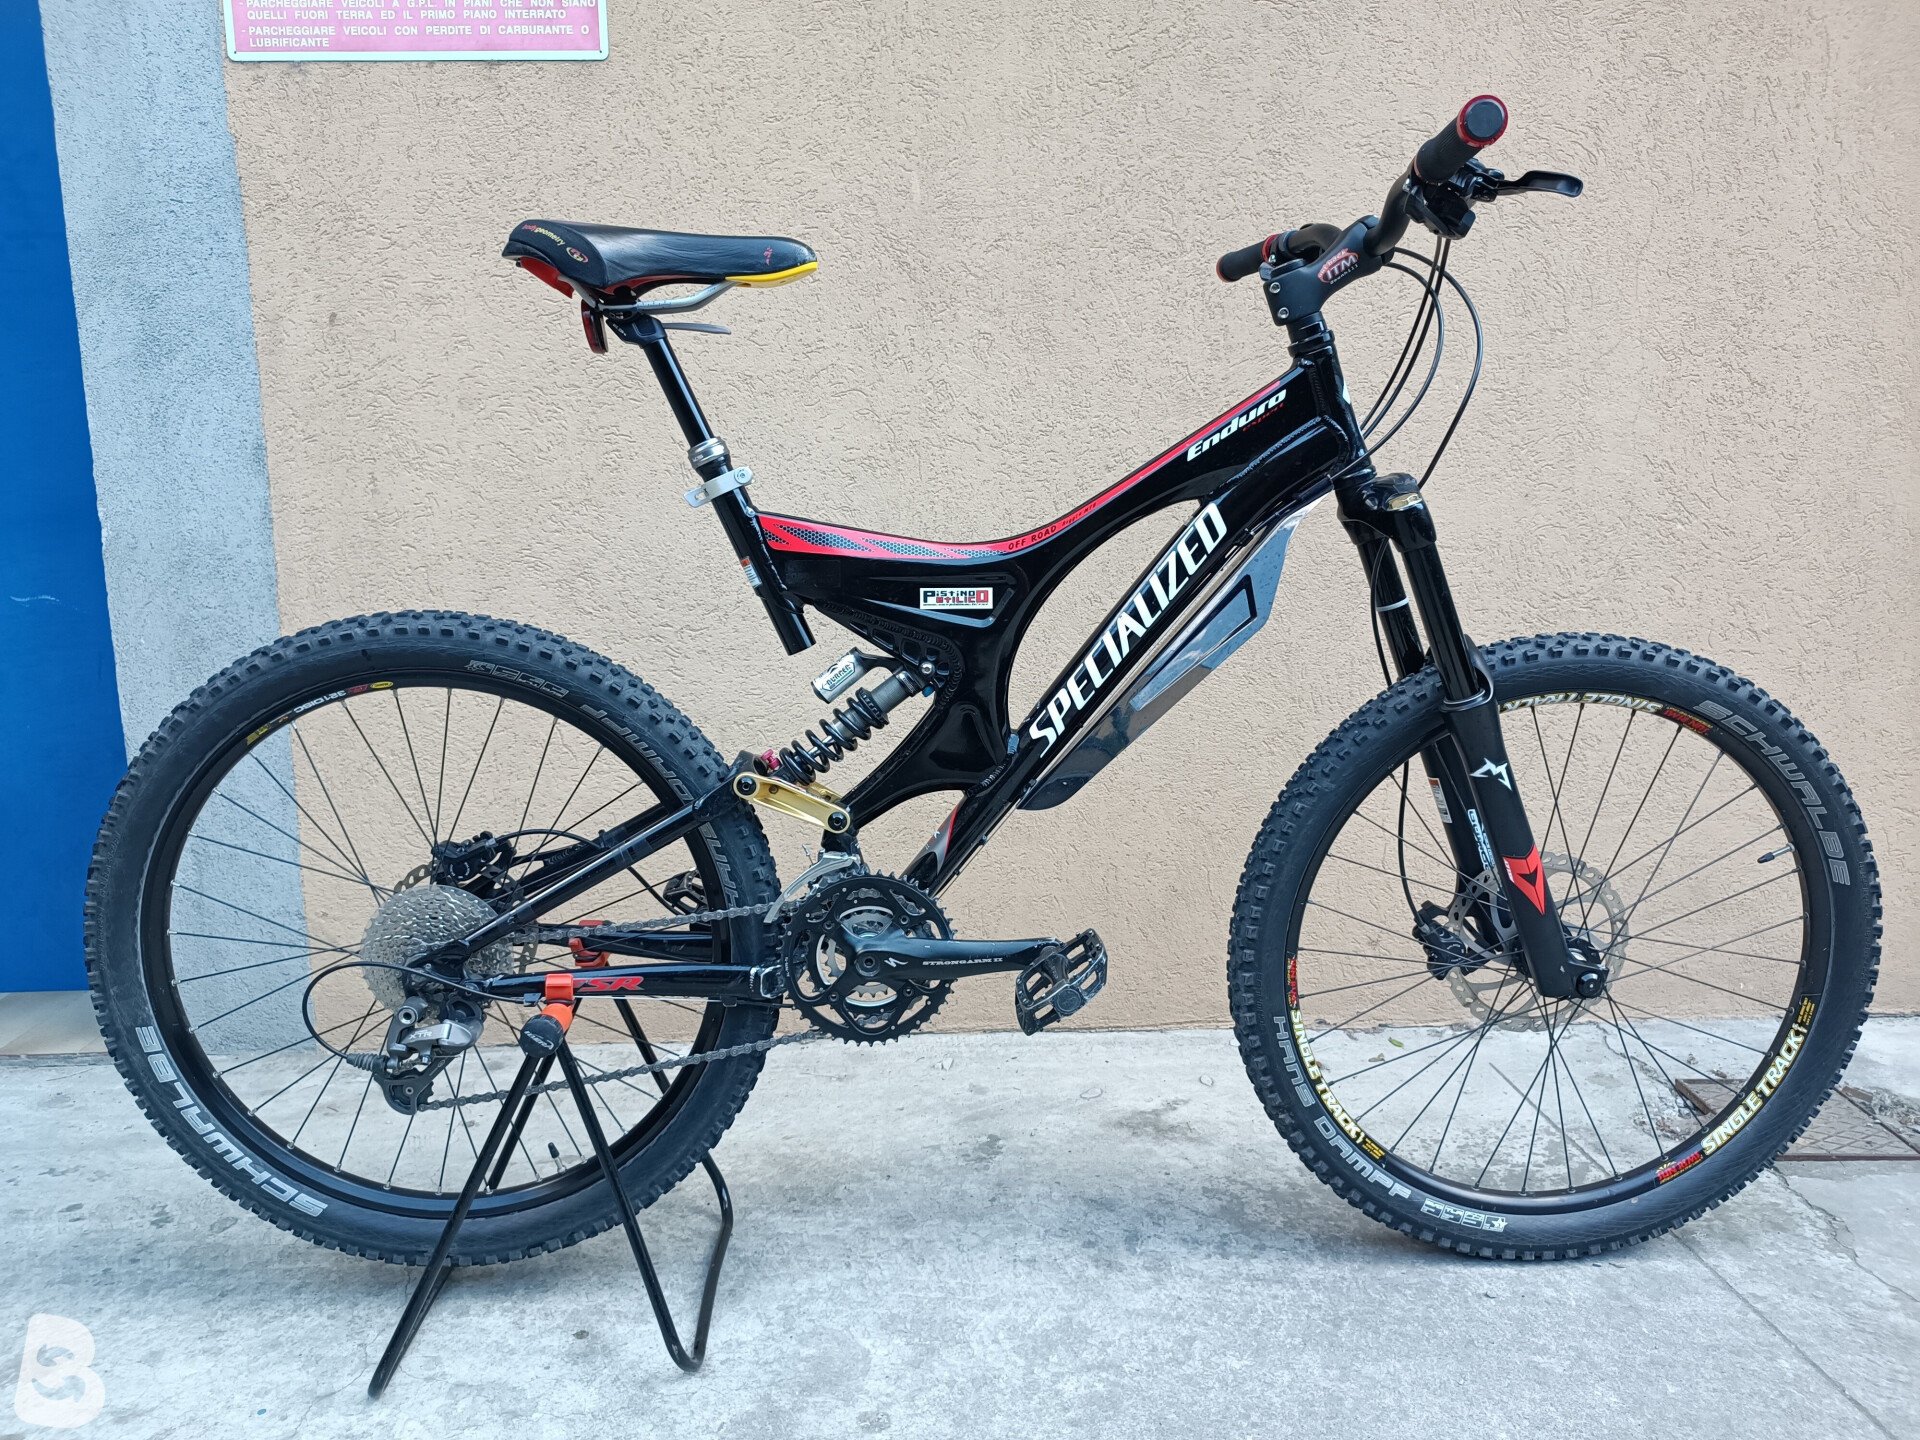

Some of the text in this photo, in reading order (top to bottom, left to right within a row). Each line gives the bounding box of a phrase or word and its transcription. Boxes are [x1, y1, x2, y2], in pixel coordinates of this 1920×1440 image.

[247, 9, 567, 20] QUELLI FUORI TERRA ED IL PRIMO PIANO INTERRATO
[342, 0, 385, 8] VEICOLI
[248, 26, 336, 36] PARCHEGGIARE
[343, 26, 387, 35] VEICOLI
[394, 26, 418, 35] CON
[425, 25, 473, 35] PERDITE
[480, 25, 491, 35] DI
[498, 25, 574, 35] CARBURANTE
[580, 25, 590, 34] O
[249, 37, 330, 48] LUBRIFICANTE
[1326, 254, 1358, 281] ITM
[1186, 388, 1287, 462] Enduro
[1008, 525, 1058, 551] OFF ROAD
[1028, 502, 1228, 759] SPECIALIZED
[1692, 699, 1851, 887] SCHWALBE
[922, 958, 993, 966] STRONGARM
[408, 1029, 433, 1040] XTR
[1290, 1009, 1322, 1081] SINGLE
[1700, 1028, 1805, 1156] SINGLE TRACK
[134, 1025, 329, 1218] SCHWALBE
[1273, 1016, 1413, 1200] HANS DAMPF
